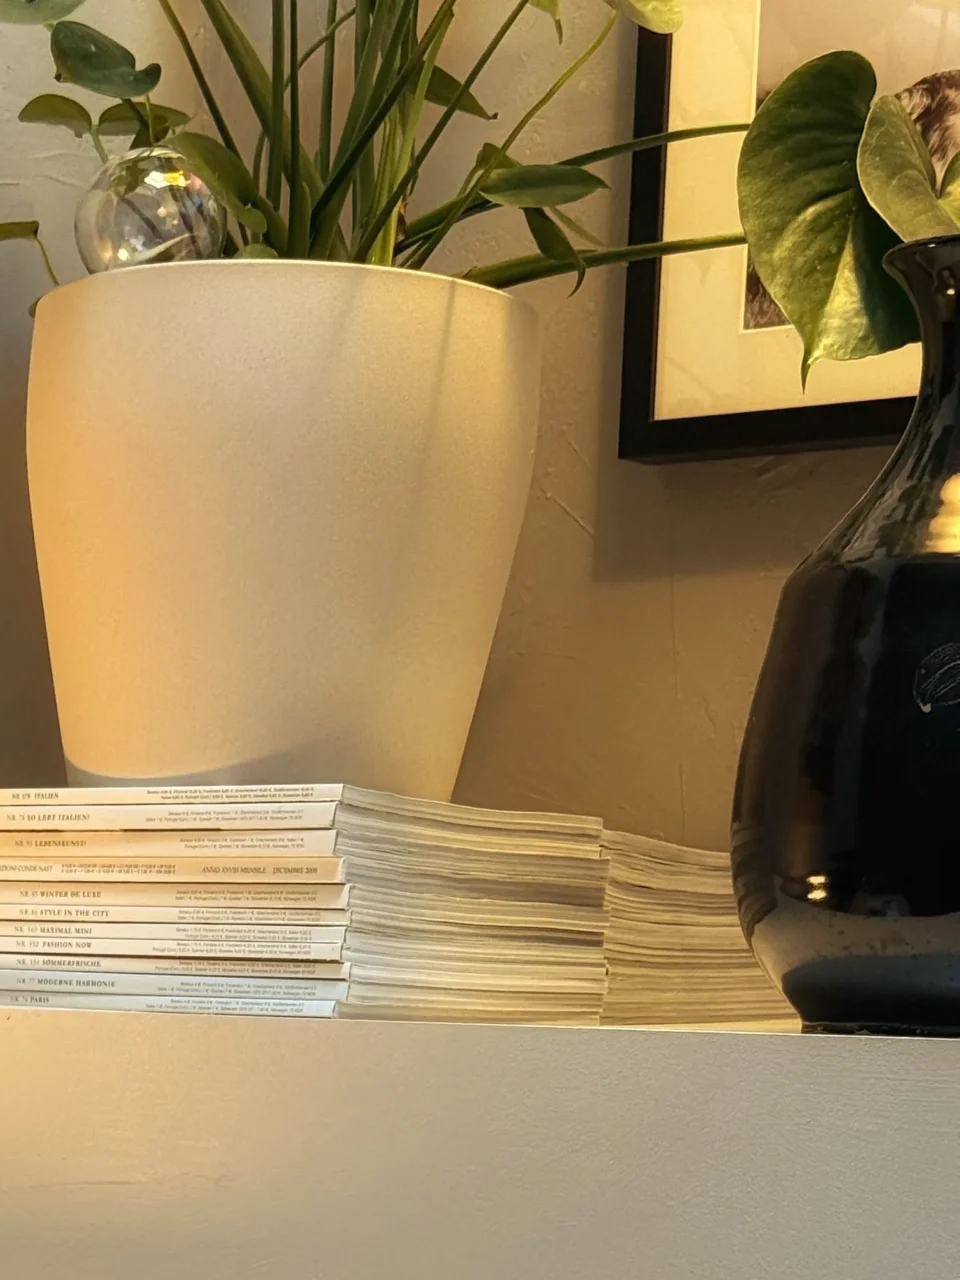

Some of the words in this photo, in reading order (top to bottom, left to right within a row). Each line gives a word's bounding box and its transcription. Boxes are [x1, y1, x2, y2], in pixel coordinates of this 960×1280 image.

[34, 792, 59, 800] ITALIEN
[39, 890, 69, 898] WINTER
[82, 890, 102, 898] LUXE
[40, 909, 62, 917] STYLE
[64, 909, 73, 917] IN
[75, 909, 90, 917] THE
[92, 909, 110, 918] CITY
[40, 926, 73, 935] MAXIMAL
[75, 927, 92, 936] MINI
[76, 941, 93, 949] NOW
[42, 960, 102, 968] SOMMERFRISCHE
[37, 978, 74, 987] MODERNE
[75, 979, 116, 988] HARMONIE
[30, 995, 50, 1004] PARIS
